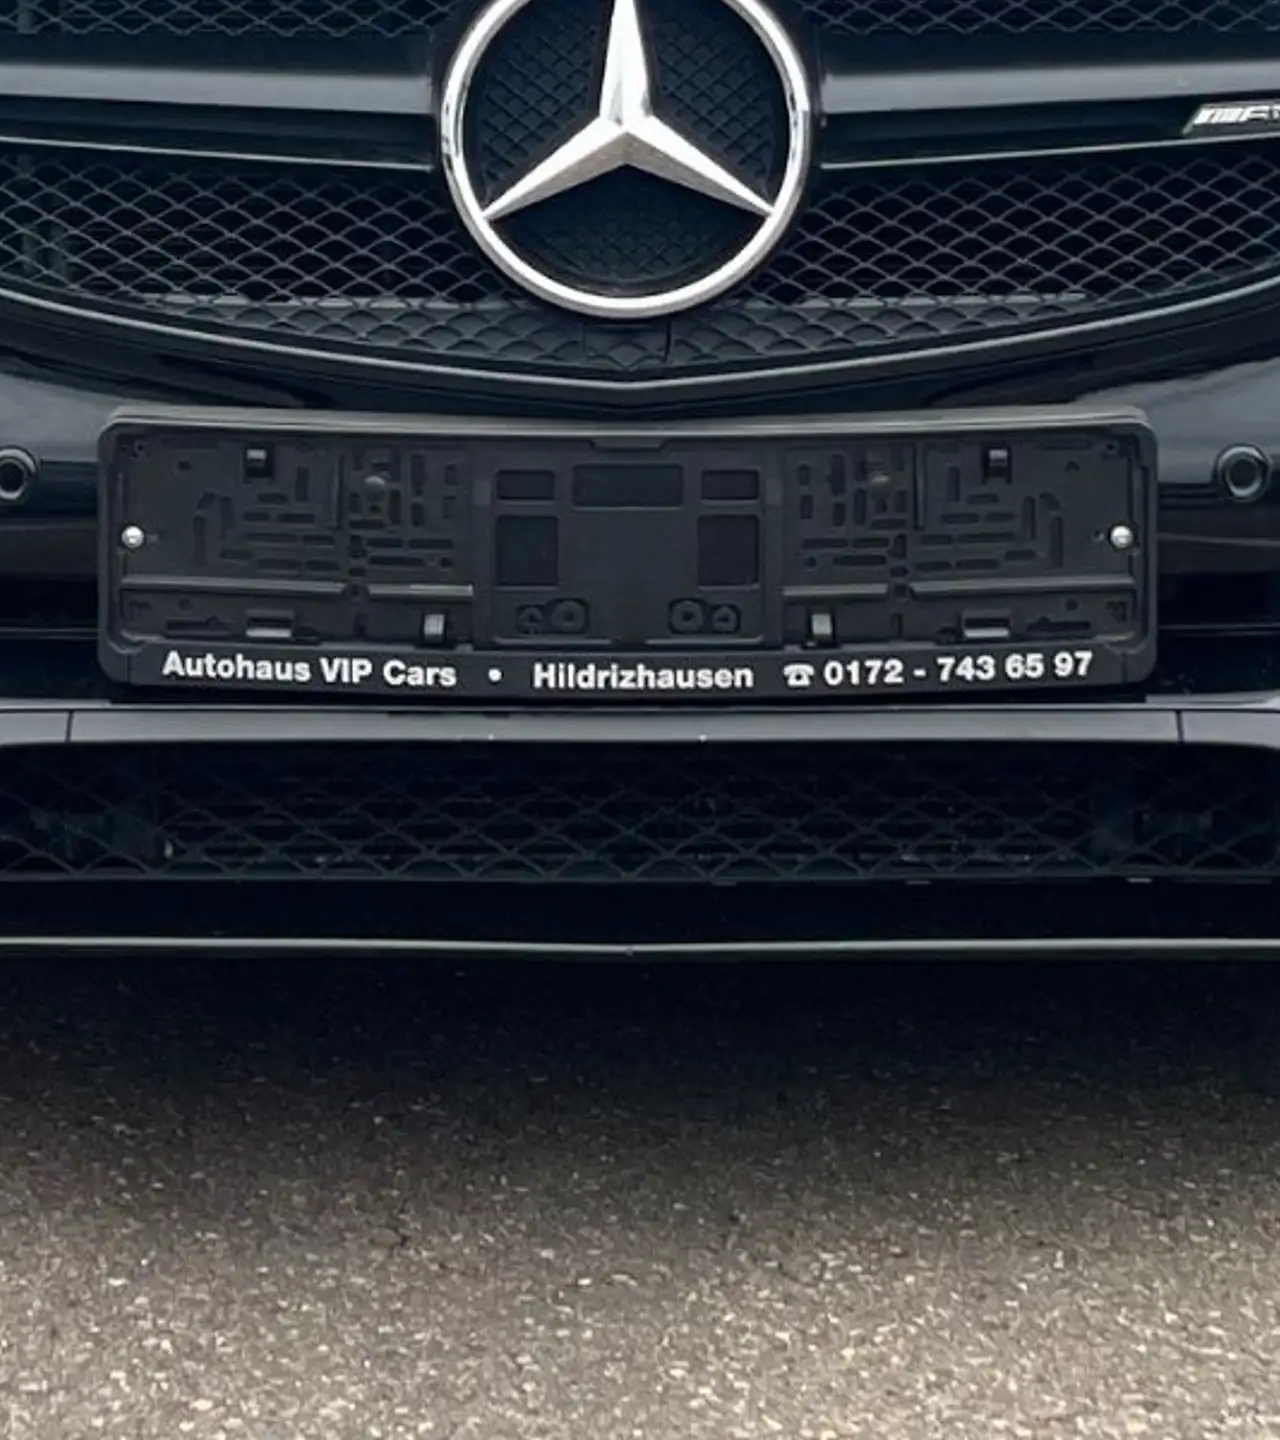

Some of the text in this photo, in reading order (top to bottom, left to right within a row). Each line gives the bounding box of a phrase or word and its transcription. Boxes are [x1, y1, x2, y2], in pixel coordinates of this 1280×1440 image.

[162, 650, 312, 682] Autohaus
[319, 657, 373, 684] VIP
[382, 659, 457, 687] Cars
[533, 662, 754, 690] Hildrizhausen
[823, 658, 904, 686] 0172
[936, 654, 996, 682] 743
[1004, 652, 1045, 679] 65
[1053, 650, 1093, 677] 97
